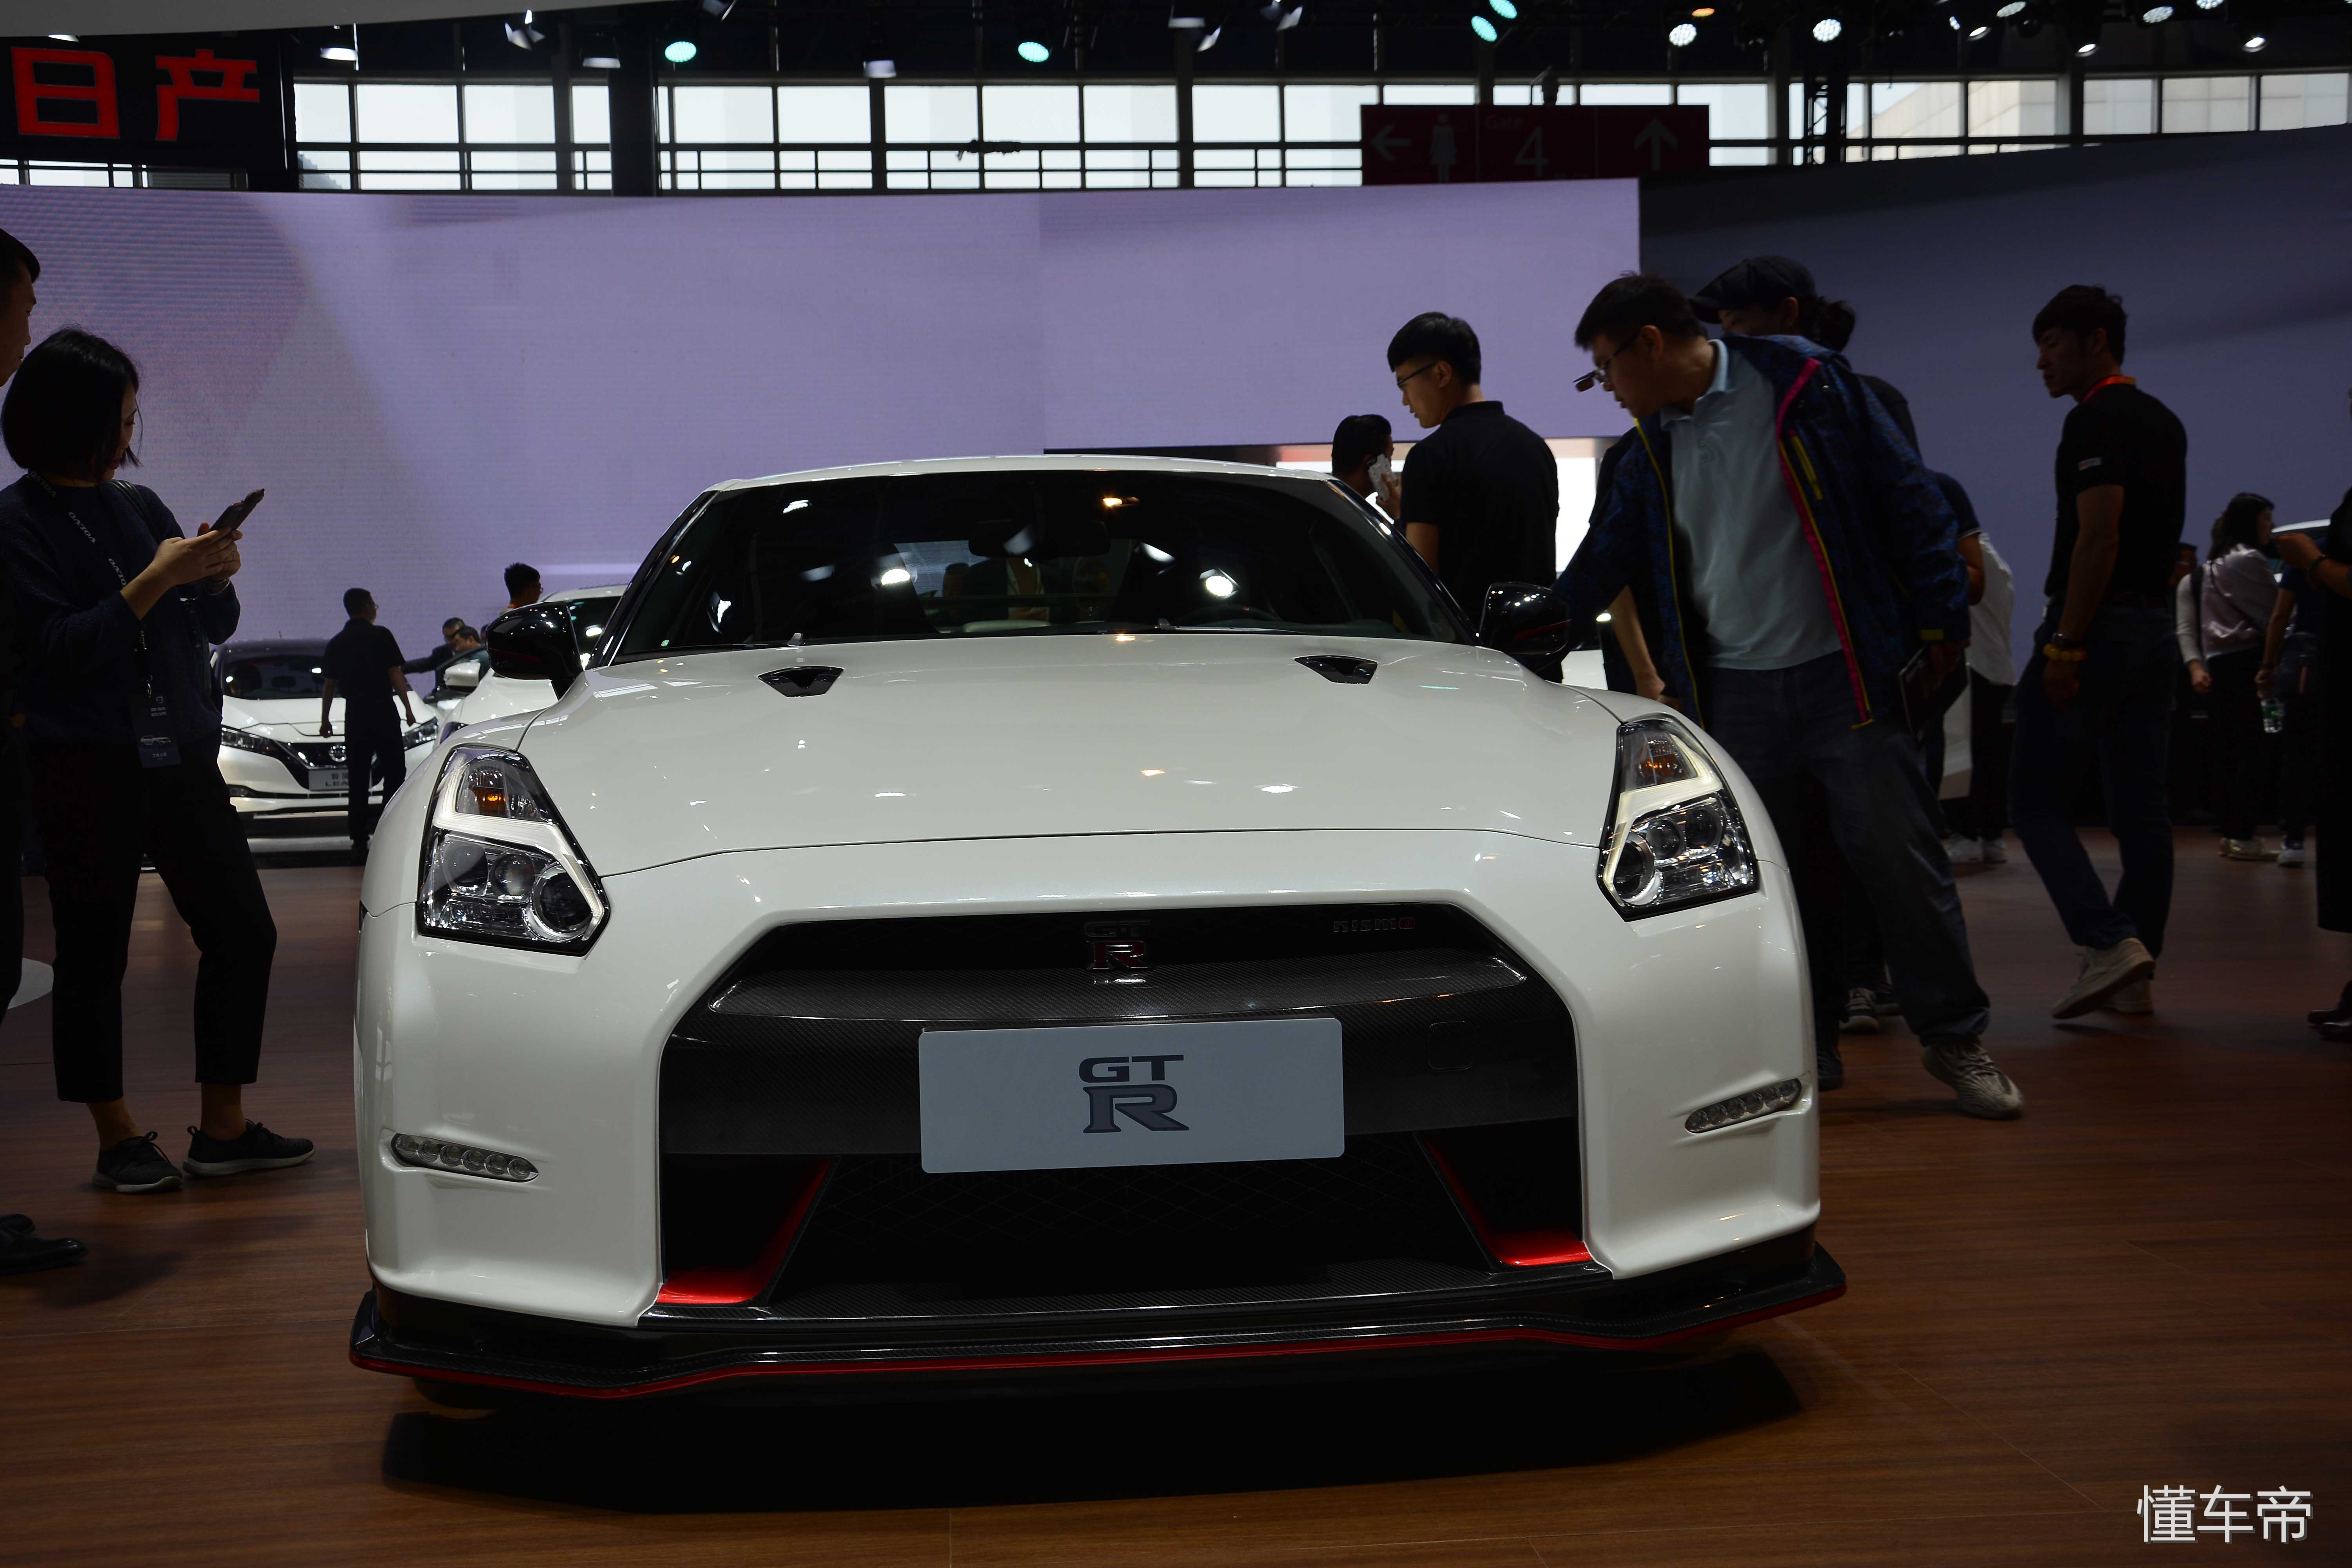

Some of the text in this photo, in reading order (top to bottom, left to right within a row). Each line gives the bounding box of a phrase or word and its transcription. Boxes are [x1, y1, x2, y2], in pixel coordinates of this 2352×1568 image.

[11, 46, 260, 142] 日产
[1486, 115, 1524, 131] Gate
[1514, 125, 1549, 177] 4
[69, 512, 96, 543] VOLVO
[108, 558, 127, 586] OLVO
[1084, 920, 1151, 937] GT
[1085, 939, 1151, 970] R
[1079, 1054, 1184, 1083] GT
[1083, 1084, 1189, 1133] R
